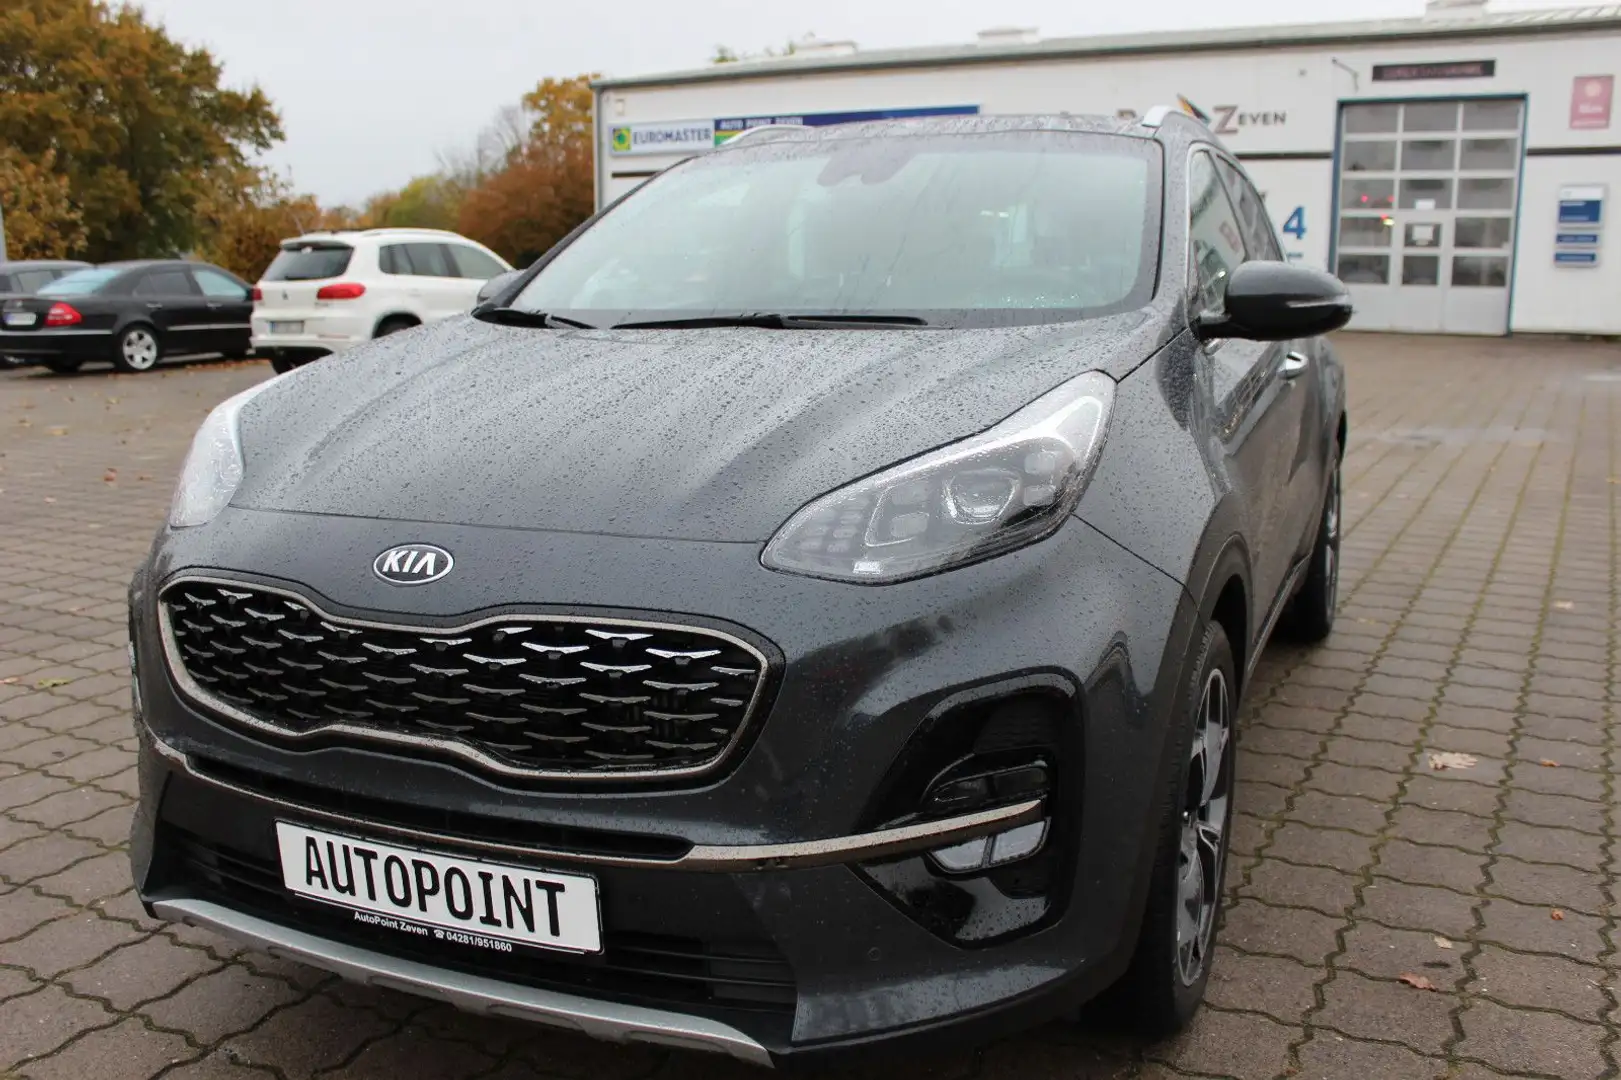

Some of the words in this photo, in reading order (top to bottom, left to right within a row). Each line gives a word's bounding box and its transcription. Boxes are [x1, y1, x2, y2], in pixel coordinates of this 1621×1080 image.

[633, 128, 711, 144] EUROMASTER
[1213, 106, 1287, 135] ZEVEN
[1283, 206, 1306, 240] 4
[382, 550, 437, 576] KIA
[305, 835, 565, 937] AUTOPOINT
[354, 911, 398, 929] AutoPoint
[400, 921, 428, 936] Zeven
[446, 931, 512, 952] 04281/951860
